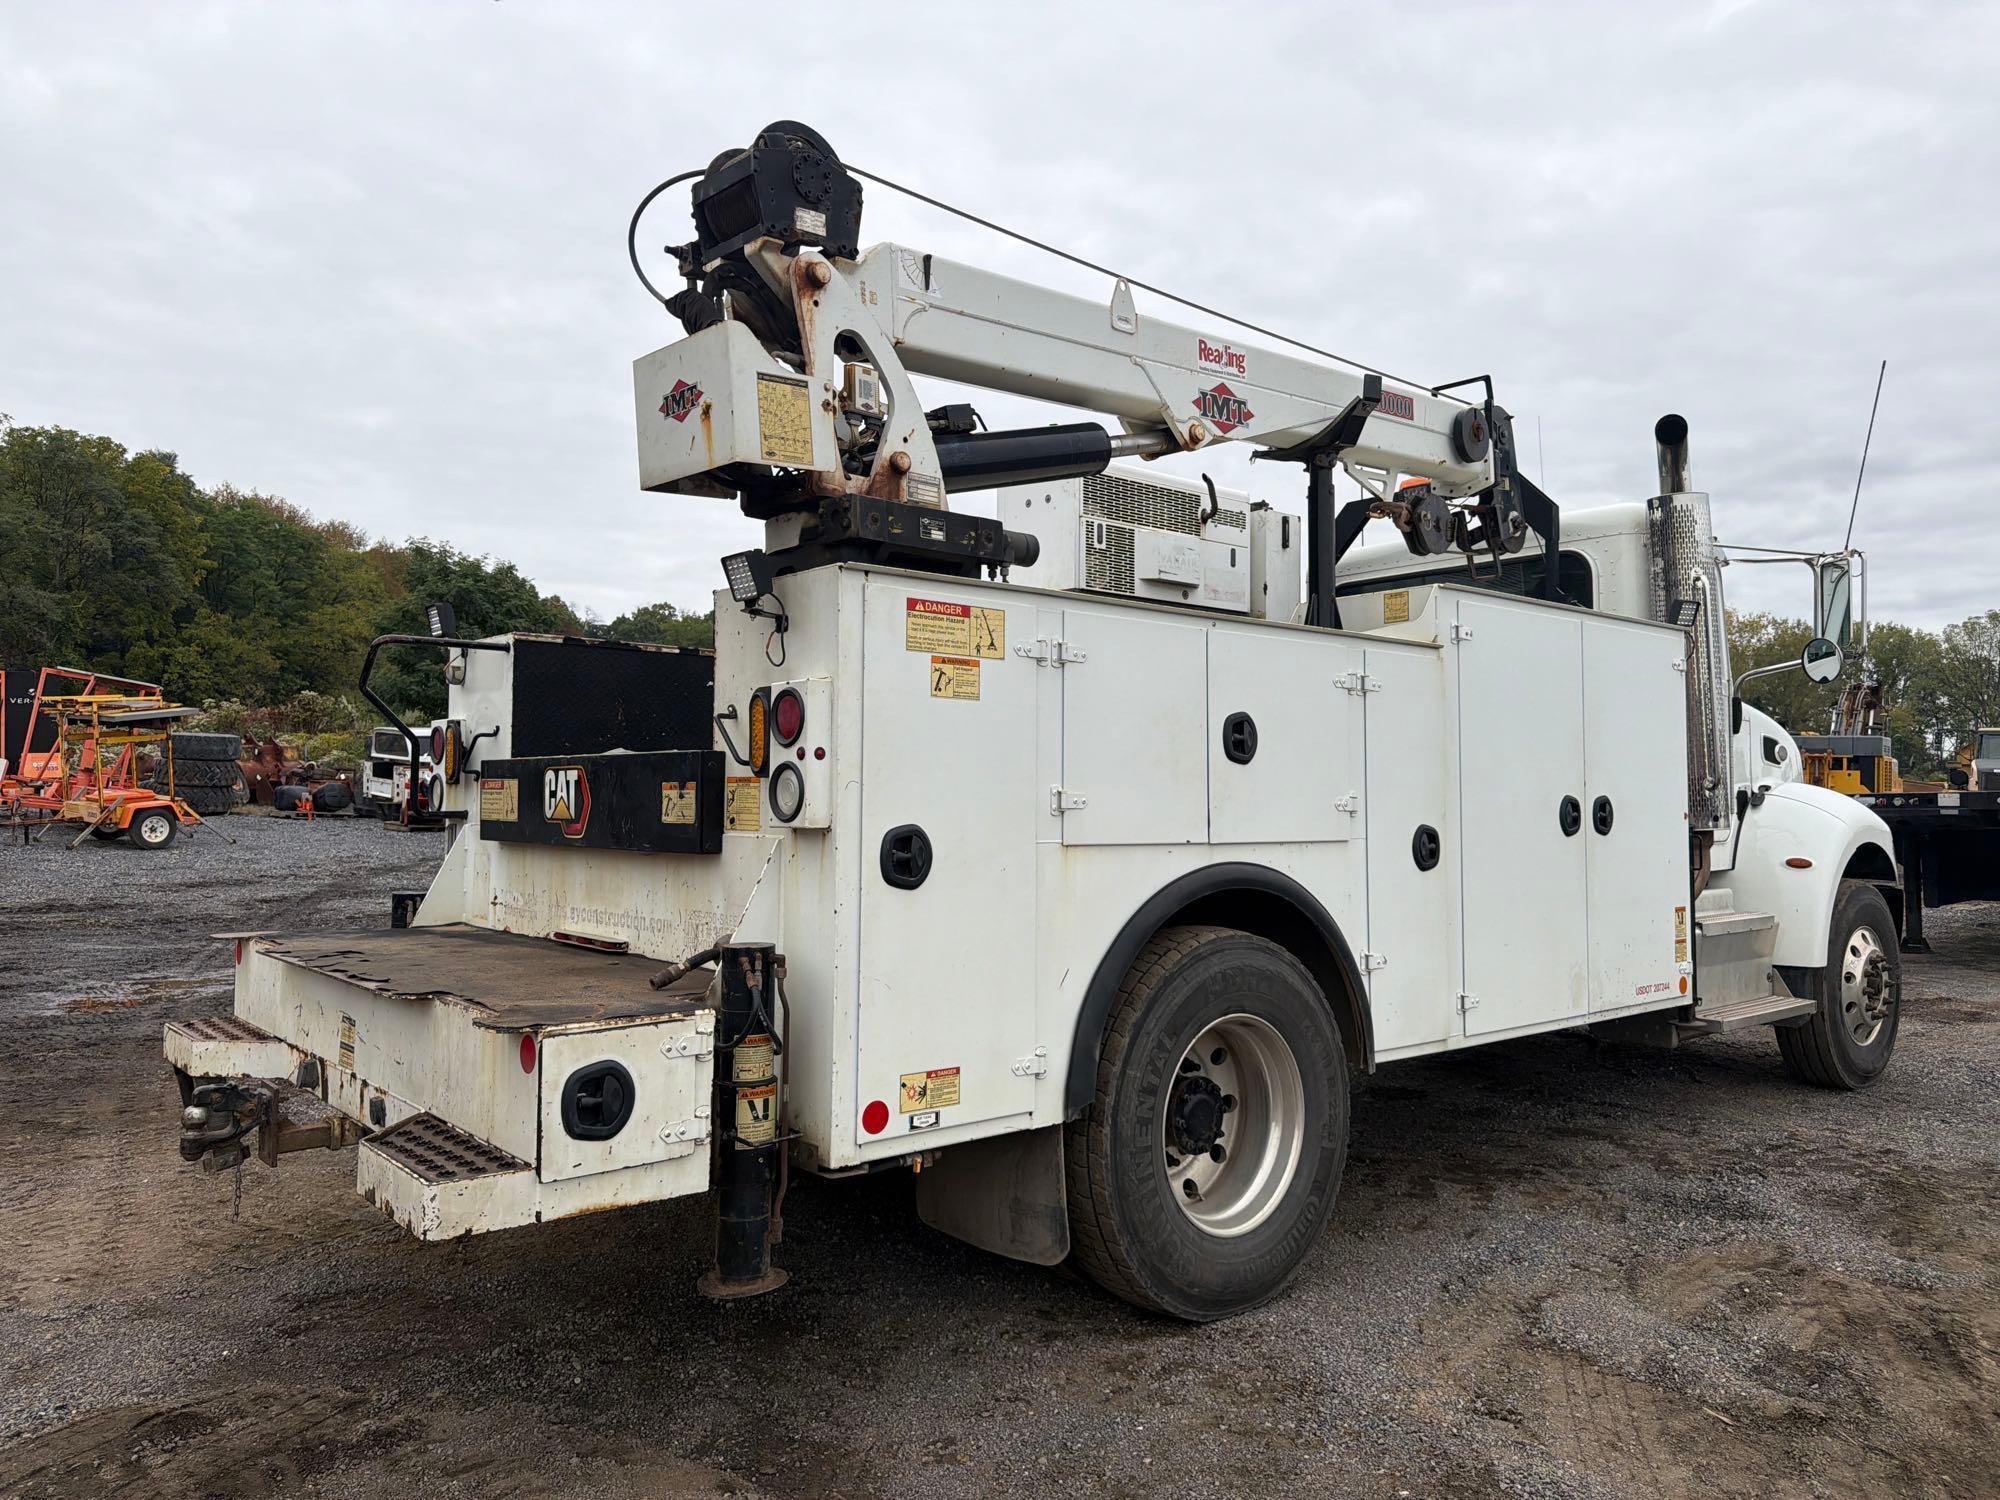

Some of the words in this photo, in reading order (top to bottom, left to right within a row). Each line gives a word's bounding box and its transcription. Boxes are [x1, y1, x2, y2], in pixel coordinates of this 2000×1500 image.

[664, 385, 699, 417] IMT
[1200, 390, 1247, 425] IMT
[1378, 393, 1412, 418] 0000
[925, 602, 962, 615] DANGER
[545, 769, 578, 820] CAT
[1636, 985, 1653, 996] USDOT
